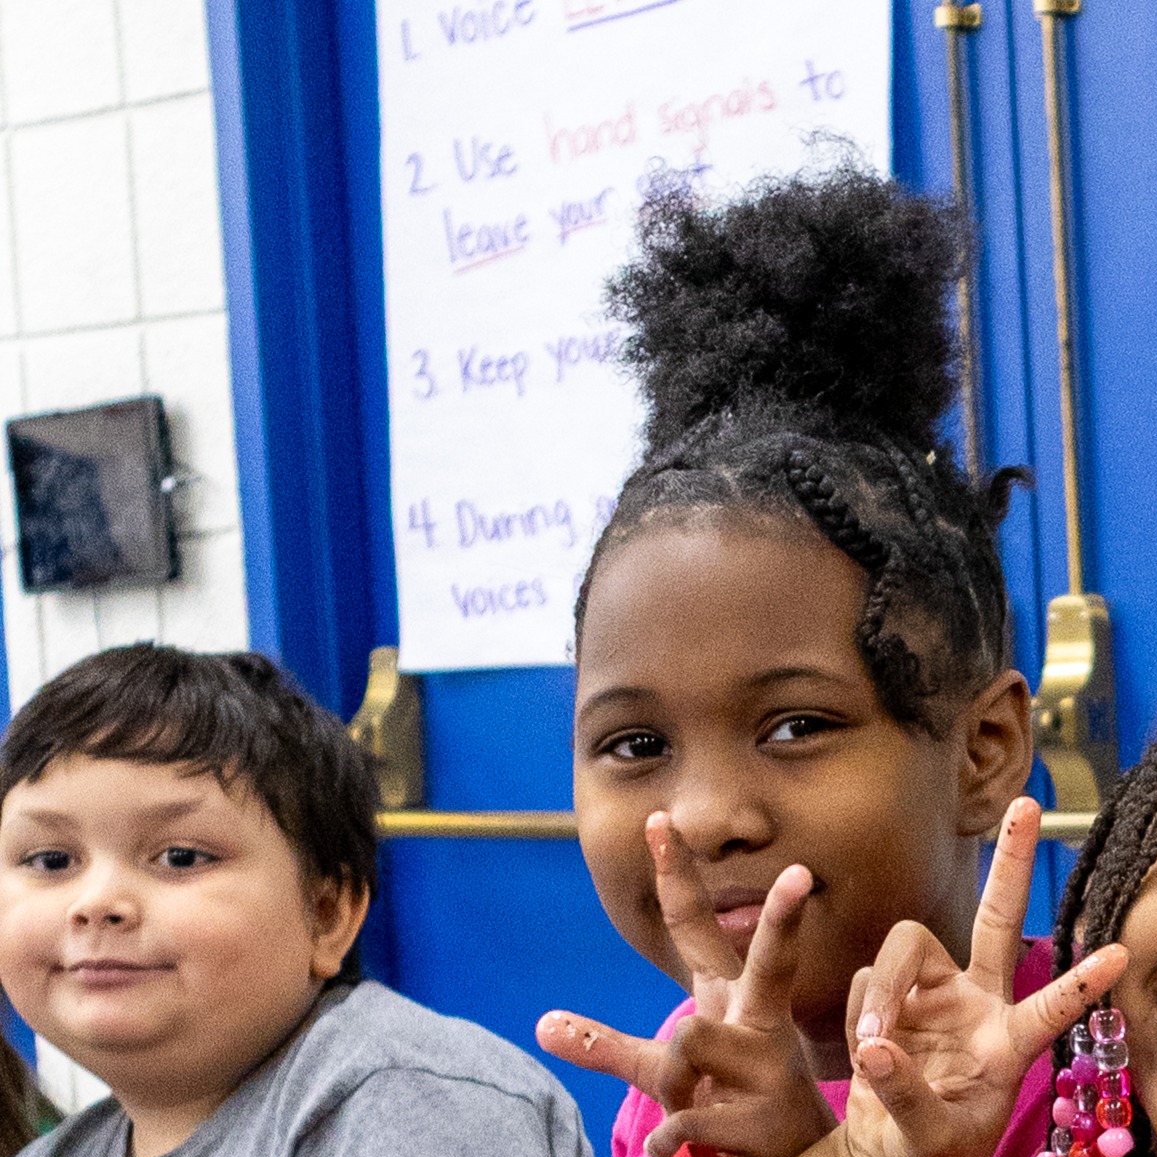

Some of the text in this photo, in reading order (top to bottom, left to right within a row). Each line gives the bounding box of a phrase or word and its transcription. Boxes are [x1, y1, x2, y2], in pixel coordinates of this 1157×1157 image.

[453, 134, 519, 184] Use
[543, 104, 637, 164] hand
[799, 58, 846, 103] to
[443, 207, 529, 265] leave
[549, 186, 616, 246] your
[457, 344, 530, 397] Keep
[454, 498, 575, 549] During
